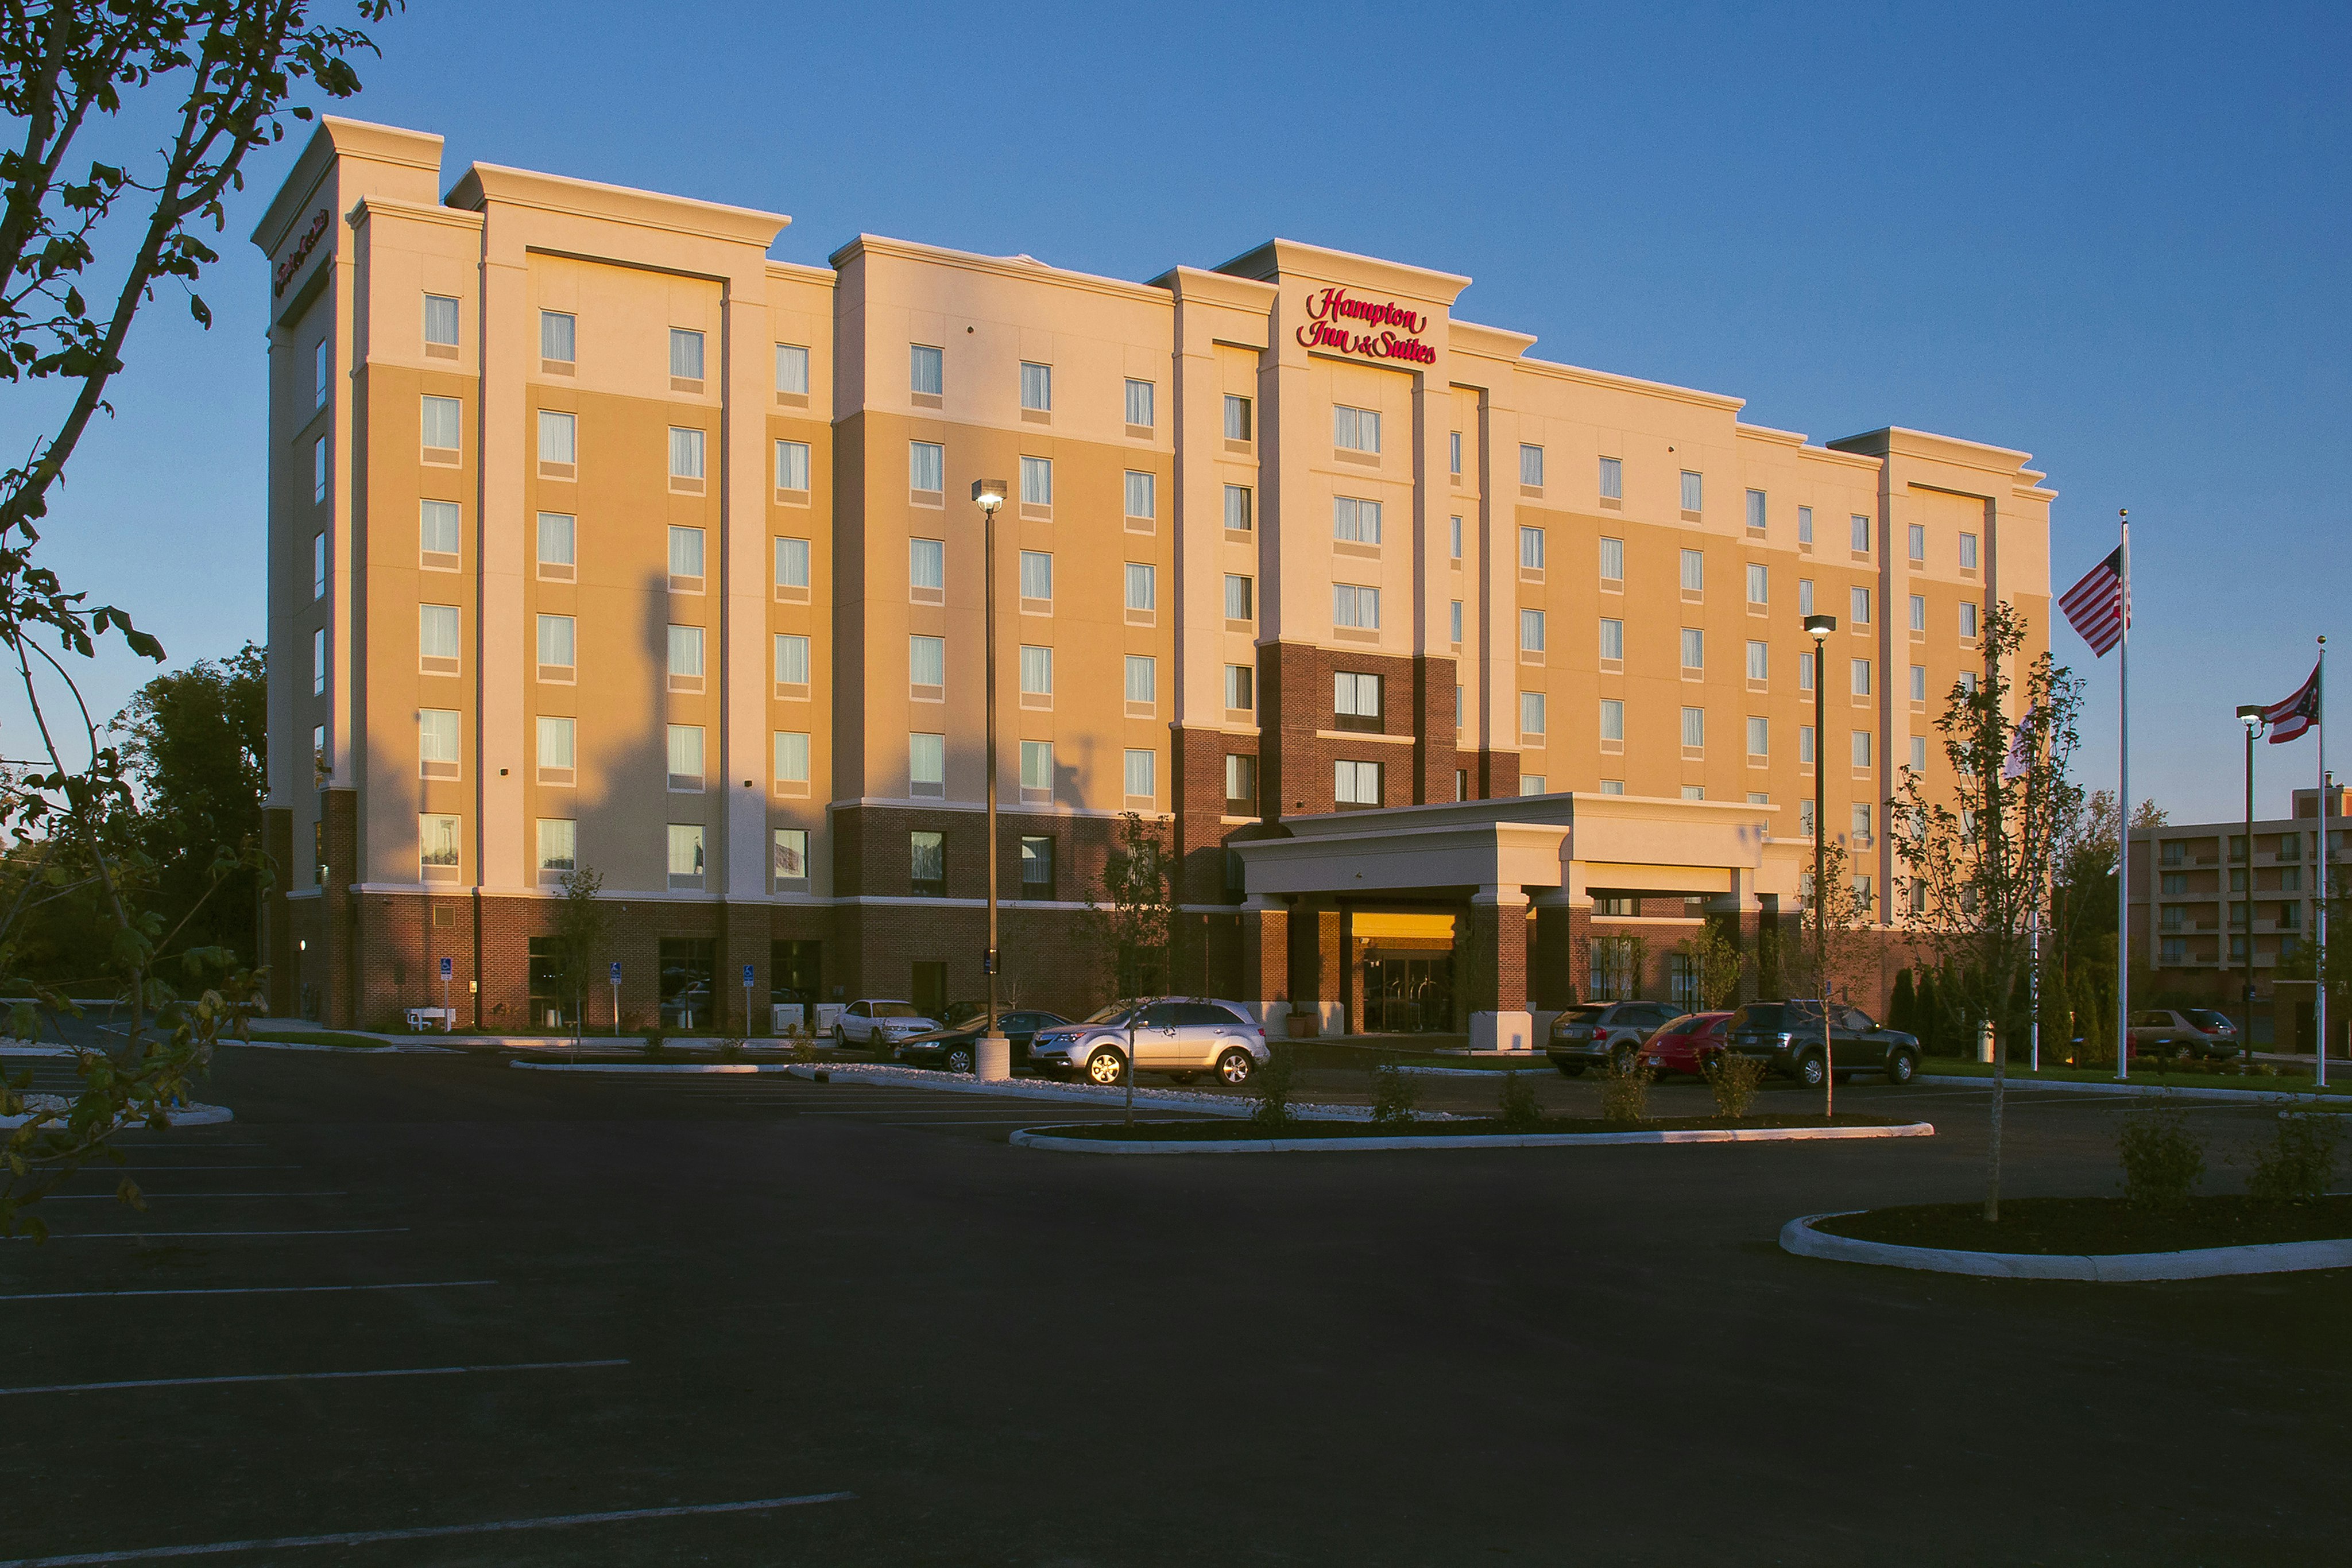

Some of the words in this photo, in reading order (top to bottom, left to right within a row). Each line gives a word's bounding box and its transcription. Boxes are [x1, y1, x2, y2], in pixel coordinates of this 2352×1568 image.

[1306, 288, 1427, 334] Hampton
[1296, 320, 1359, 354] Inn
[1358, 335, 1376, 357] &
[1372, 331, 1436, 365] Suites
